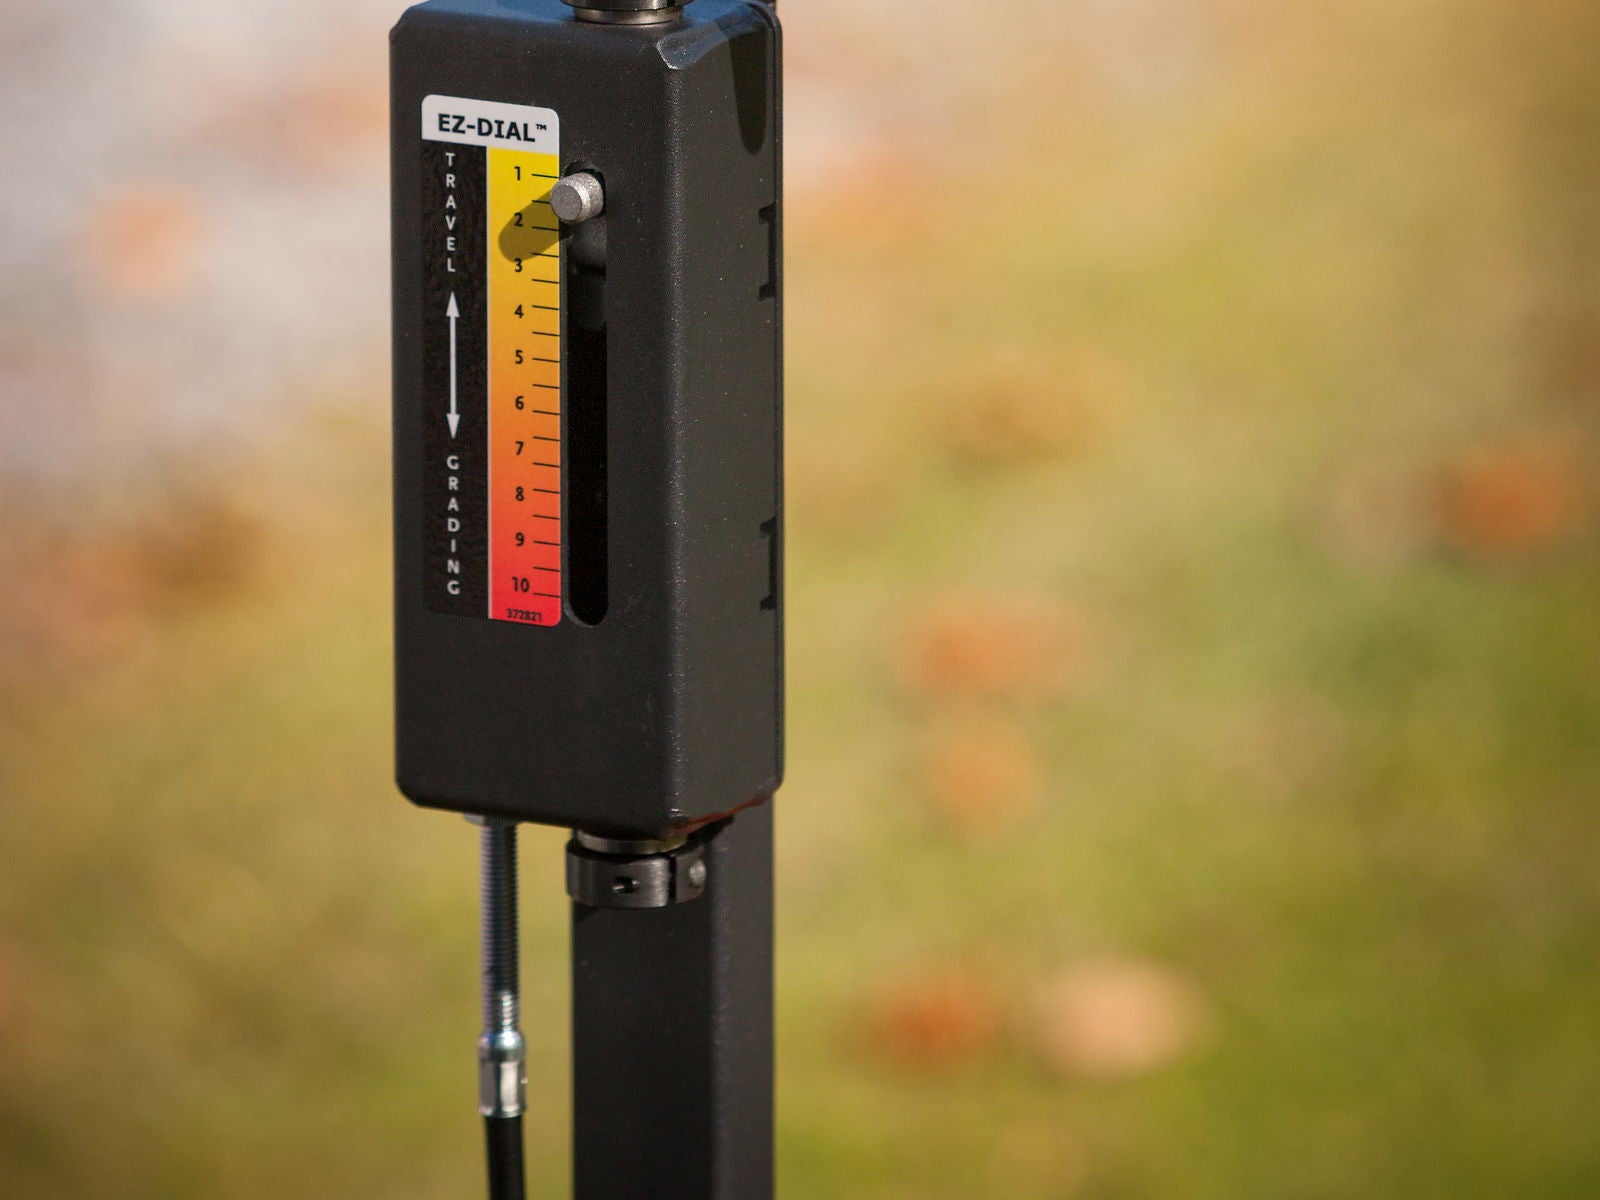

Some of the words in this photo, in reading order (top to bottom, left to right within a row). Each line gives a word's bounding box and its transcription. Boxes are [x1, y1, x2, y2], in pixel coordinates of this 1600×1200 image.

[514, 166, 521, 181] 1
[445, 152, 457, 272] TRAVEL
[514, 212, 523, 227] 2
[514, 258, 523, 273] 3
[514, 304, 524, 319] 4
[515, 350, 524, 365] 5
[515, 396, 524, 410] 6
[515, 441, 525, 456] 7
[515, 486, 525, 502] 8
[446, 455, 460, 595] GRADING
[515, 532, 525, 547] 9
[512, 577, 530, 593] 10
